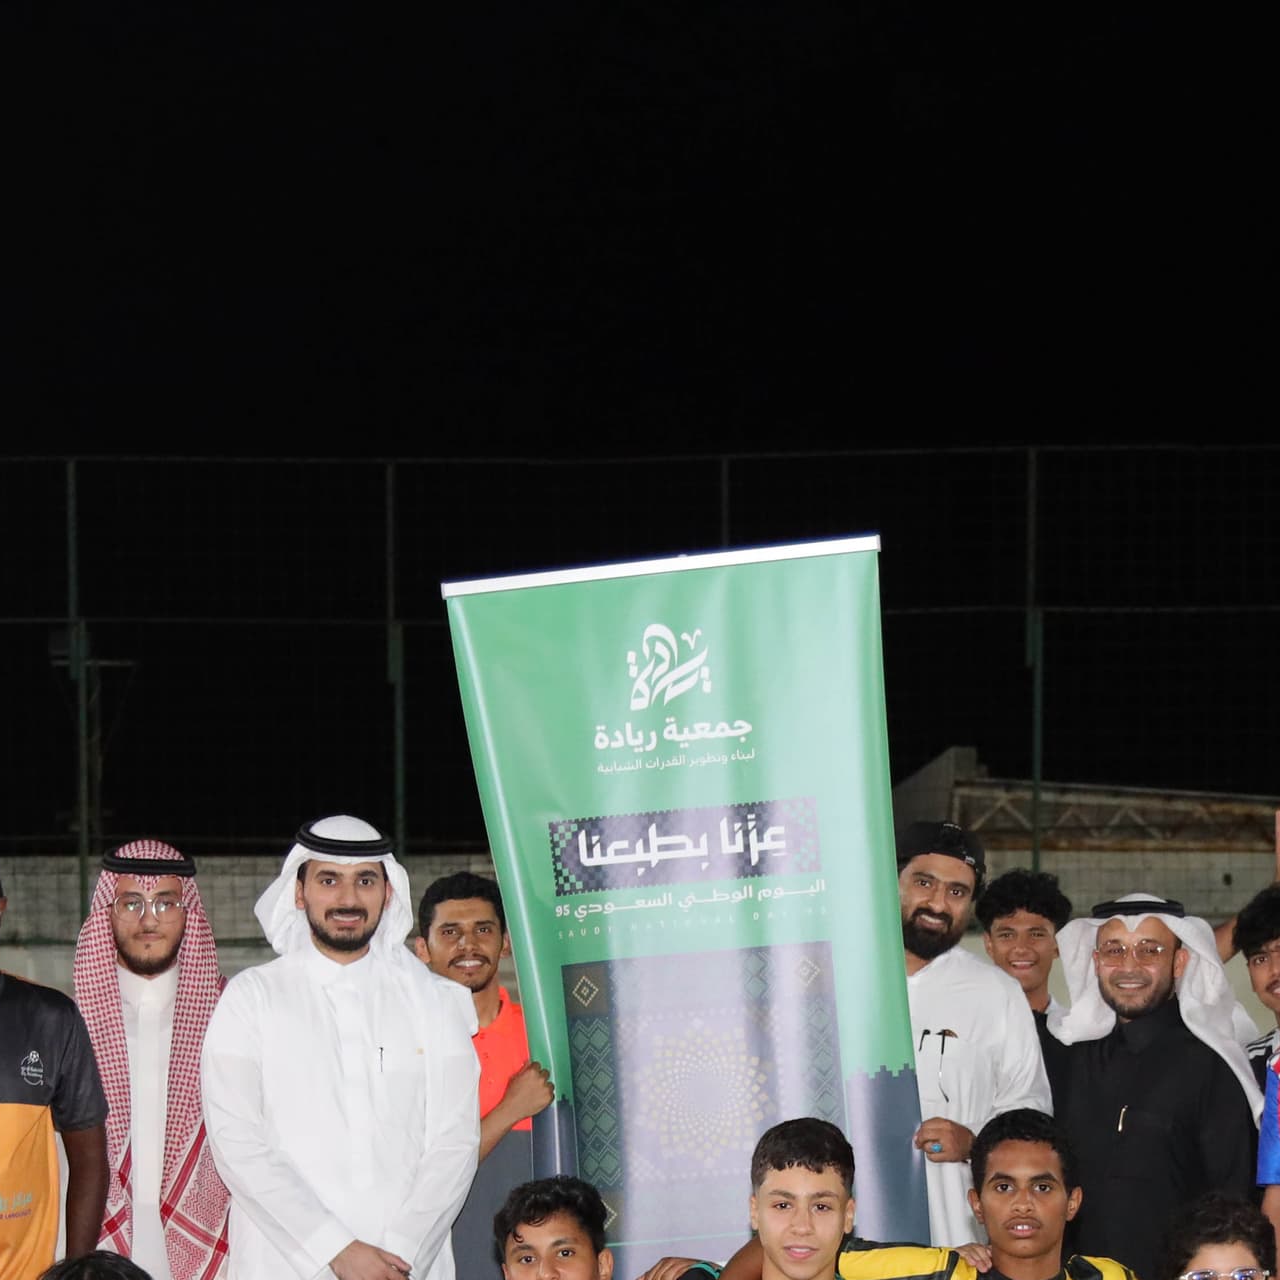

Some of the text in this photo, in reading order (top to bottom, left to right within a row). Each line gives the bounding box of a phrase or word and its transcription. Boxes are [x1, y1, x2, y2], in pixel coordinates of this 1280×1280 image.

[594, 716, 753, 753] جمعية ريادة
[578, 822, 709, 877] بطبعنا
